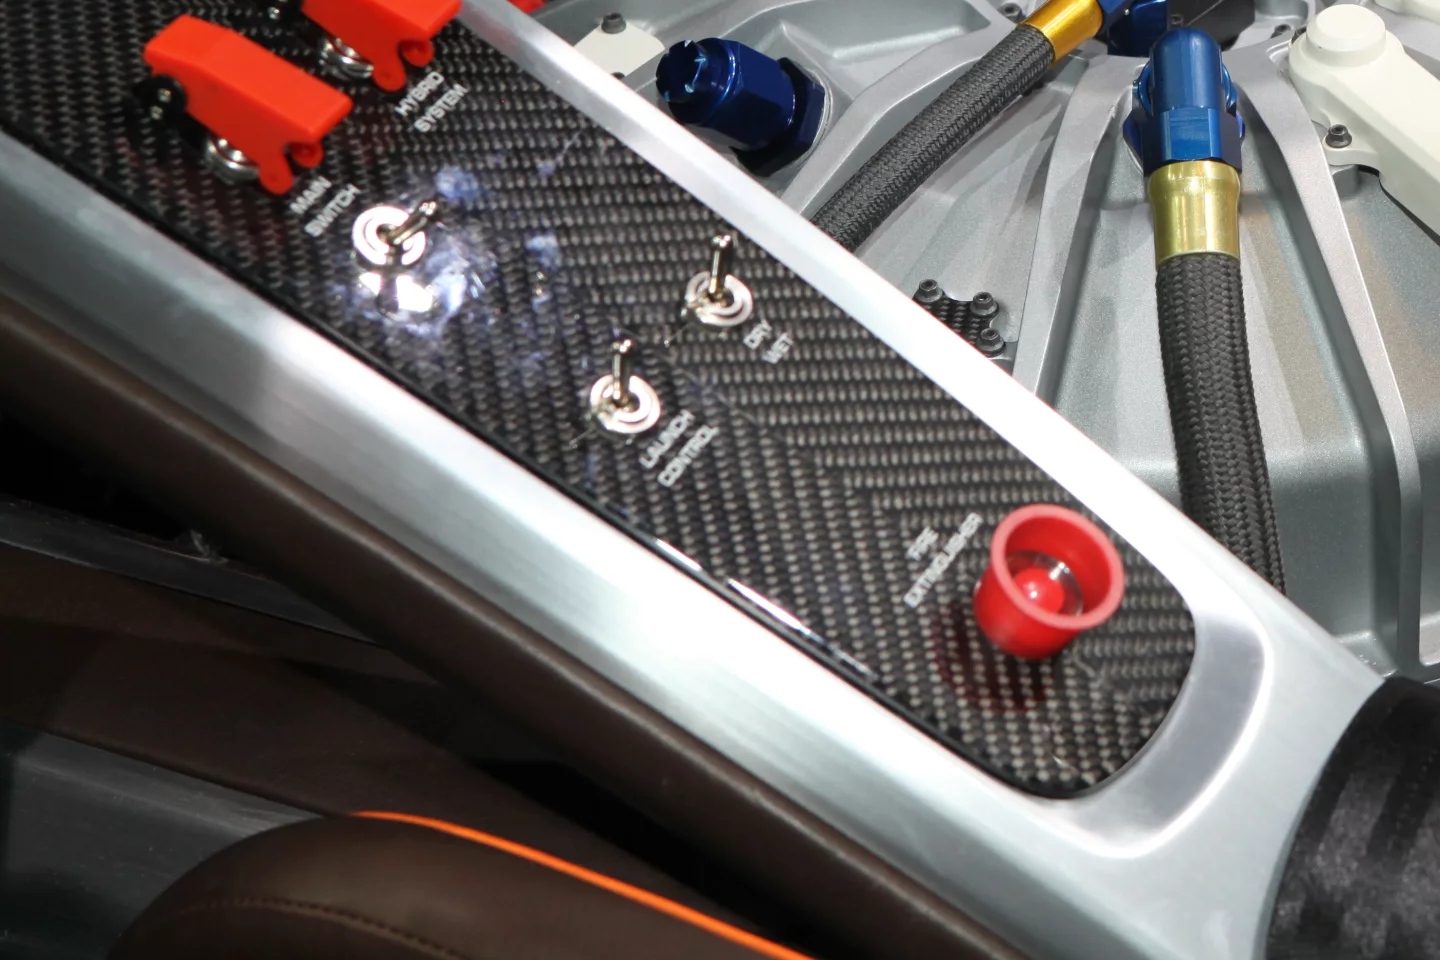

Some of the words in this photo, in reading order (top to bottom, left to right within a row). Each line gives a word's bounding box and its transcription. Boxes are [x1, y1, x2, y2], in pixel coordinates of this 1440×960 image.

[394, 71, 445, 117] HYBRID
[414, 83, 469, 133] SYSTEM
[289, 175, 332, 215] MAIN
[304, 183, 362, 238] SWITCH
[743, 318, 773, 350] DRY
[763, 332, 795, 365] WET
[638, 408, 696, 470] LAUNCH
[657, 424, 720, 488] CONTROL
[903, 512, 983, 608] EXTINGUISHER
[907, 526, 940, 561] FIRE
